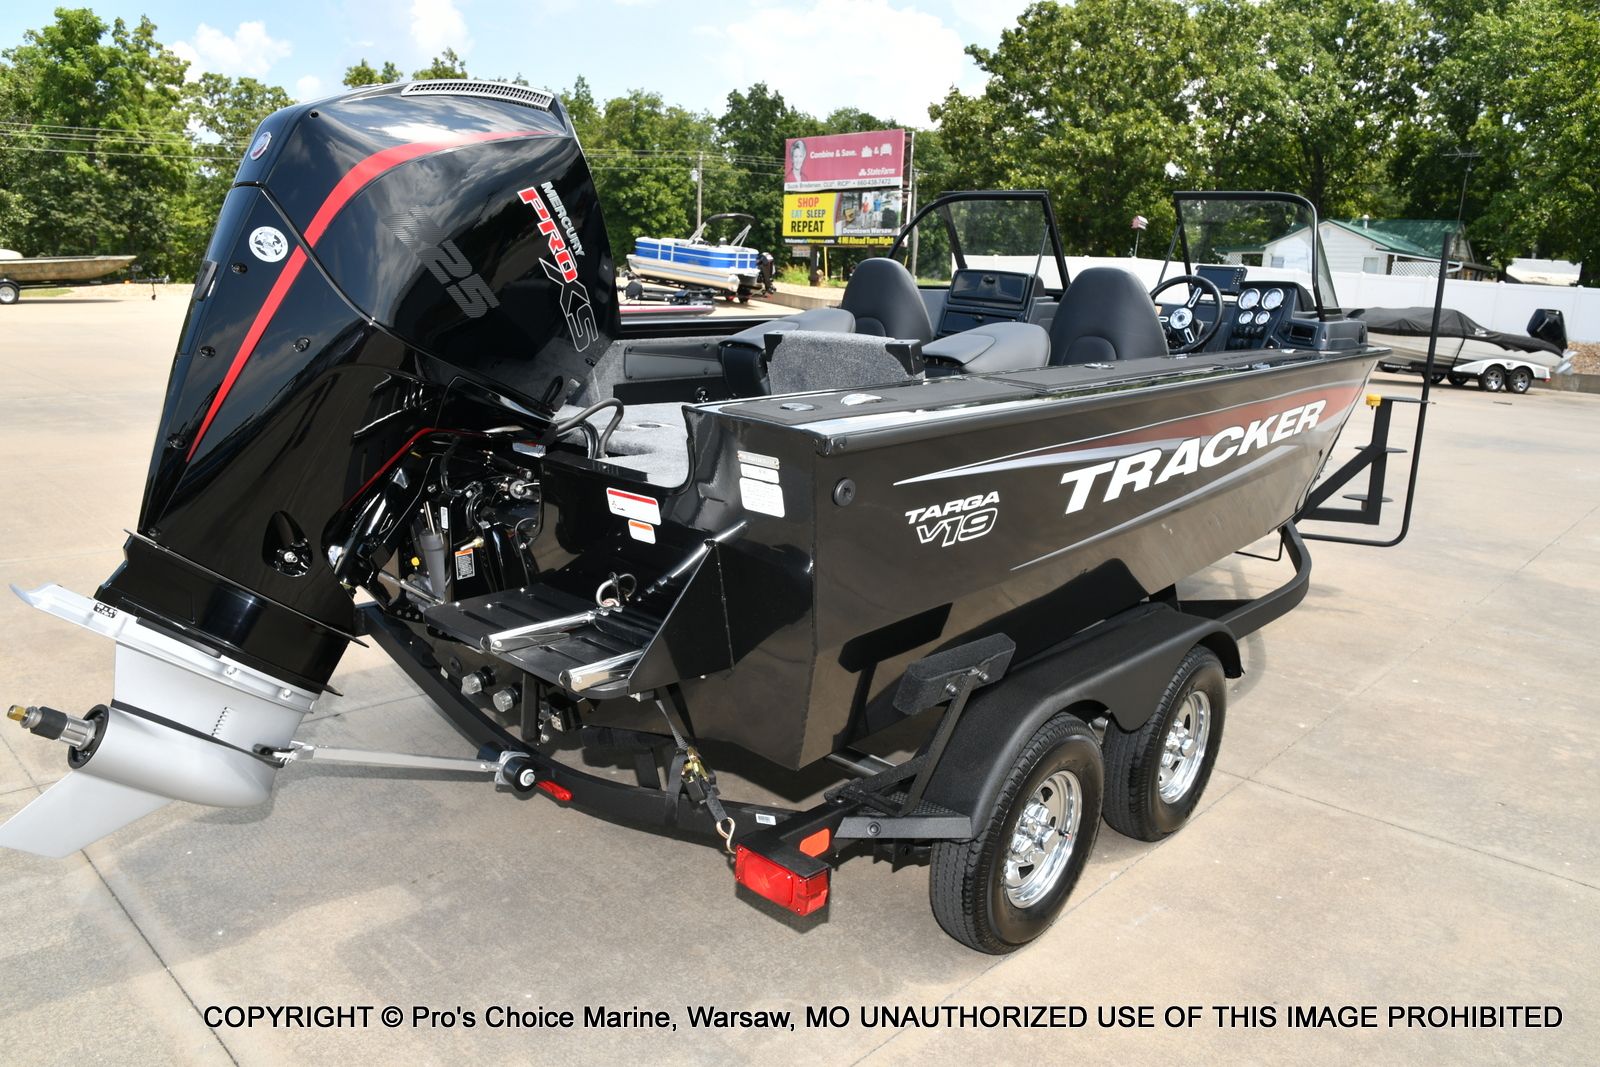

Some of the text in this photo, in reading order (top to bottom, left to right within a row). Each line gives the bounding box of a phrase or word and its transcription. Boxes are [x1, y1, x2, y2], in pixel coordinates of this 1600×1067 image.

[541, 181, 585, 257] MERCURY
[791, 209, 826, 219] EAT SLEEP
[797, 197, 819, 208] SHOP
[791, 221, 824, 232] REPEAT
[517, 187, 599, 352] PRO XS
[1060, 399, 1327, 517] TRACKER
[905, 490, 1000, 525] TARGA
[916, 507, 998, 548] V19
